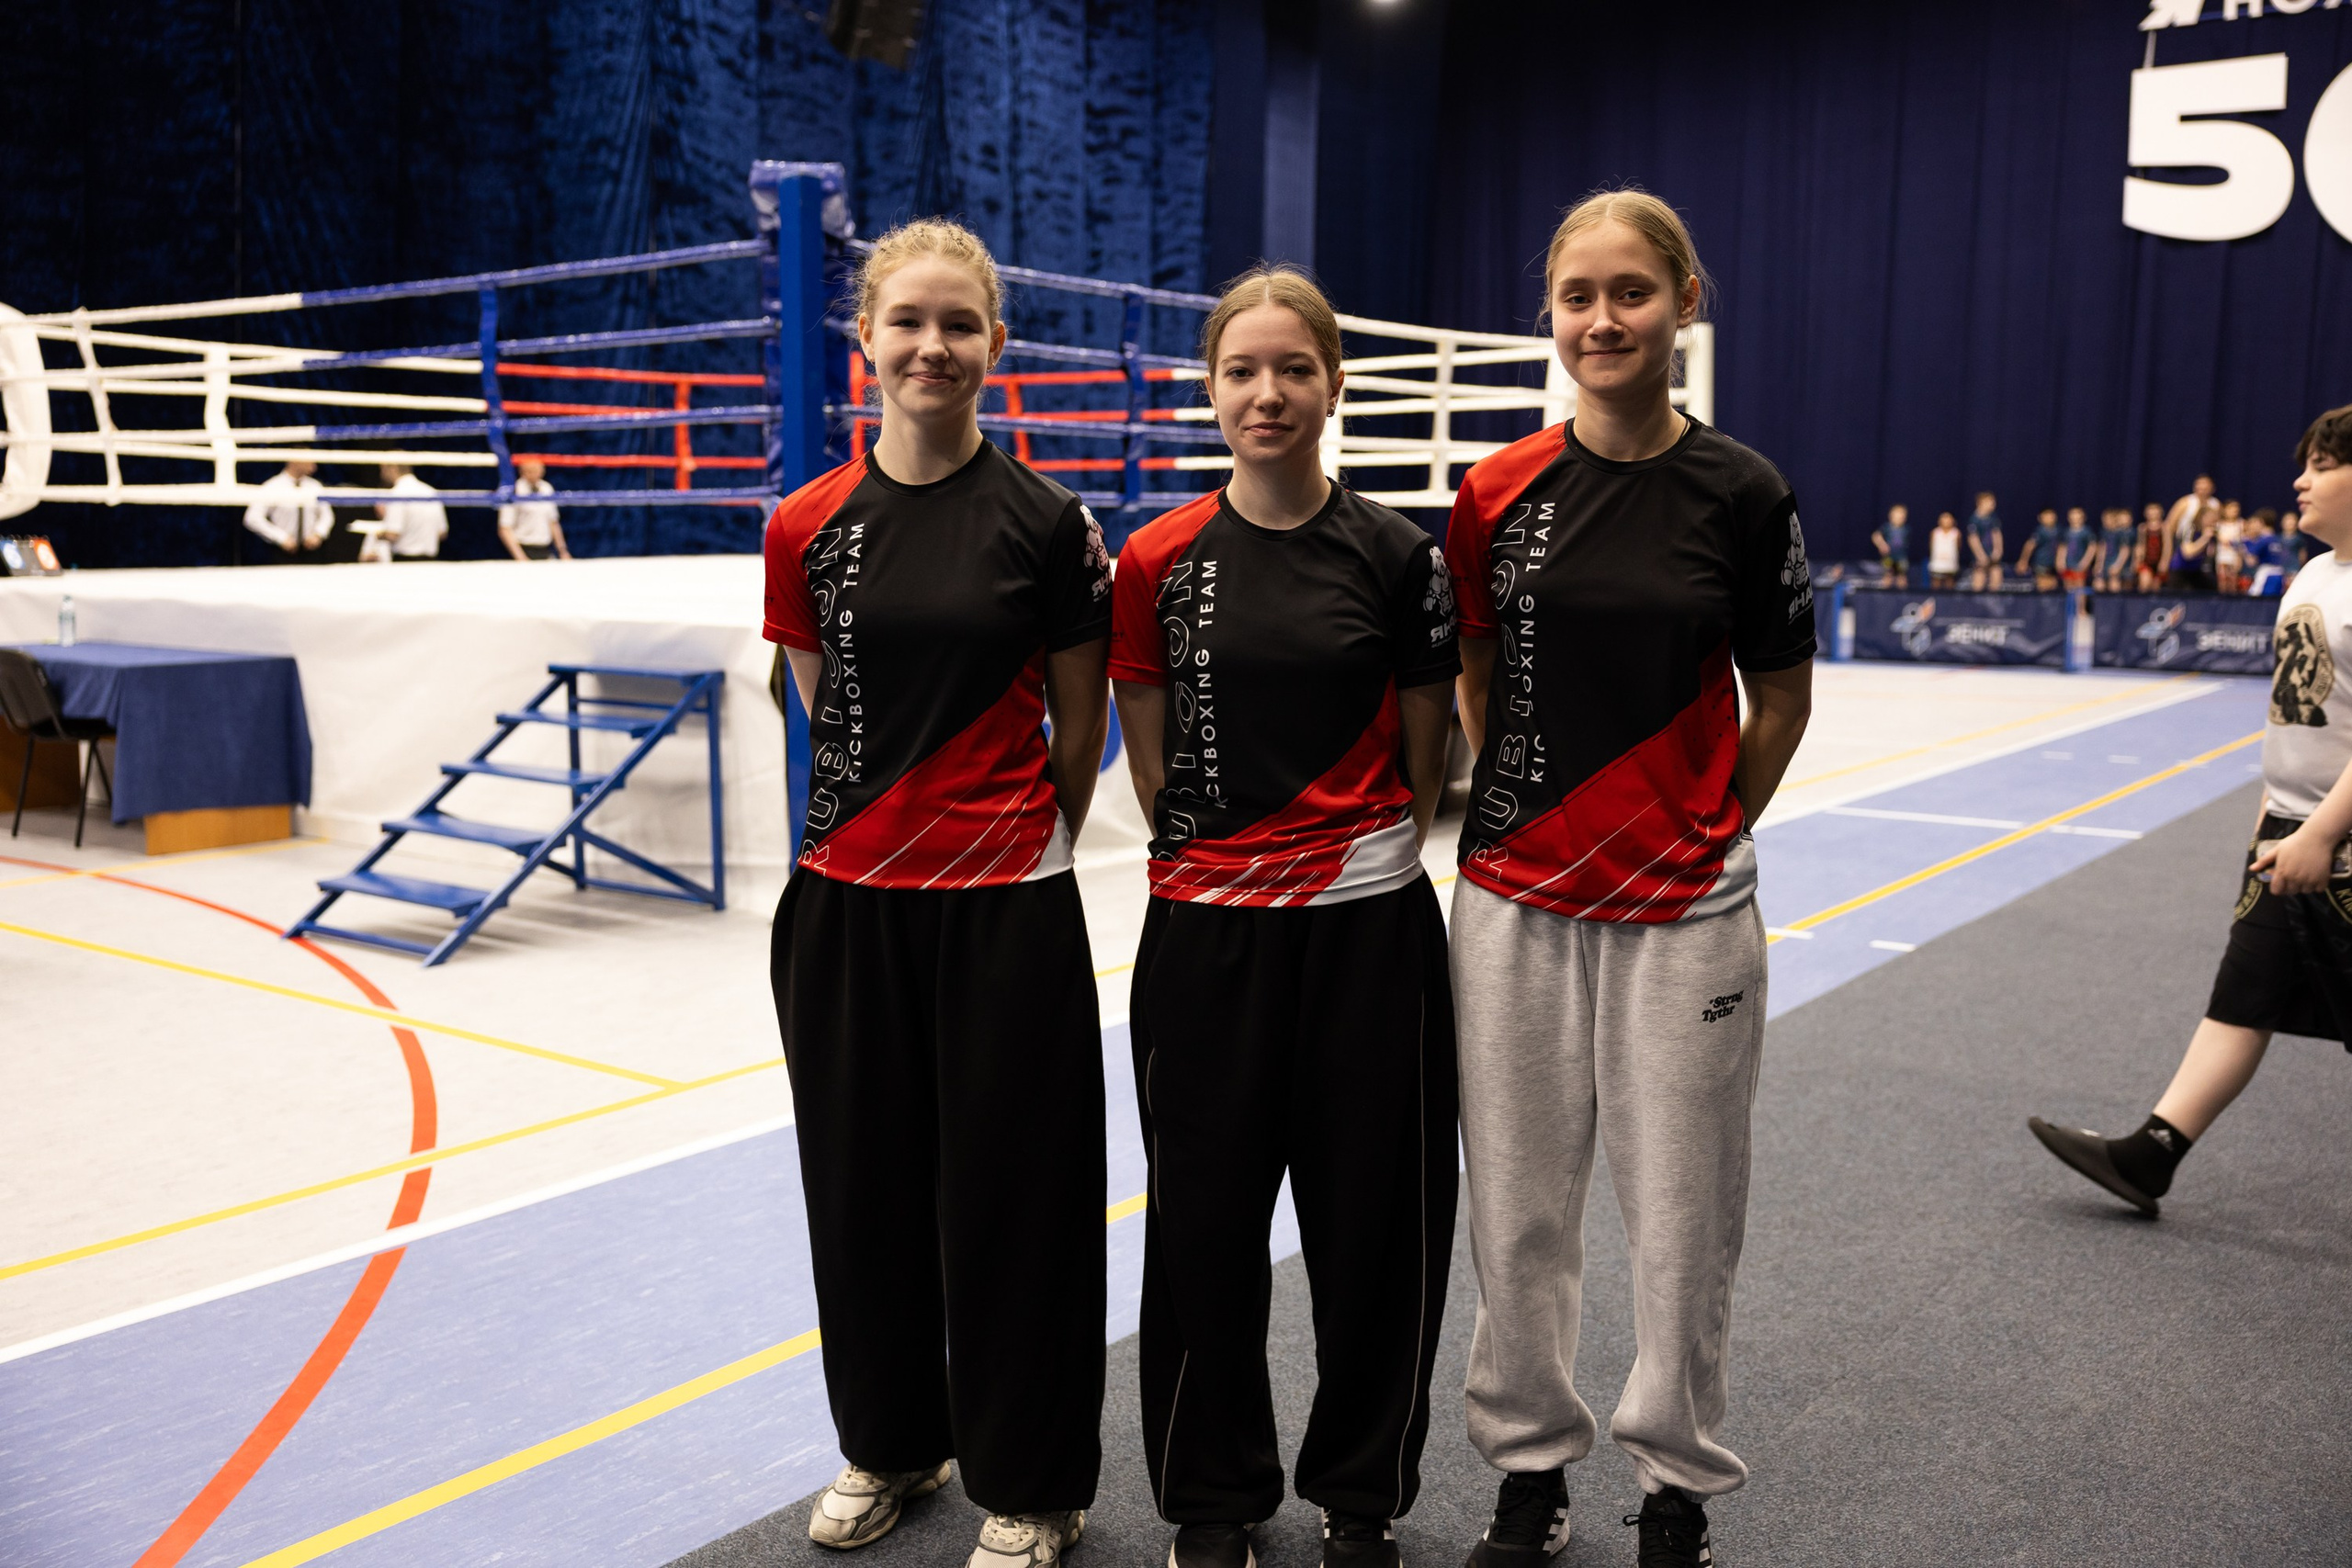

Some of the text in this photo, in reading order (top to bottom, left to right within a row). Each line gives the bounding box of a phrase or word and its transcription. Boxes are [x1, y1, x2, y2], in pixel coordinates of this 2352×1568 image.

[2121, 52, 2352, 244] 5
[1525, 501, 1555, 572] TEAM
[839, 523, 865, 783] KICKBOXING TEAM
[1194, 559, 1227, 809] KCKBOXING TEAM
